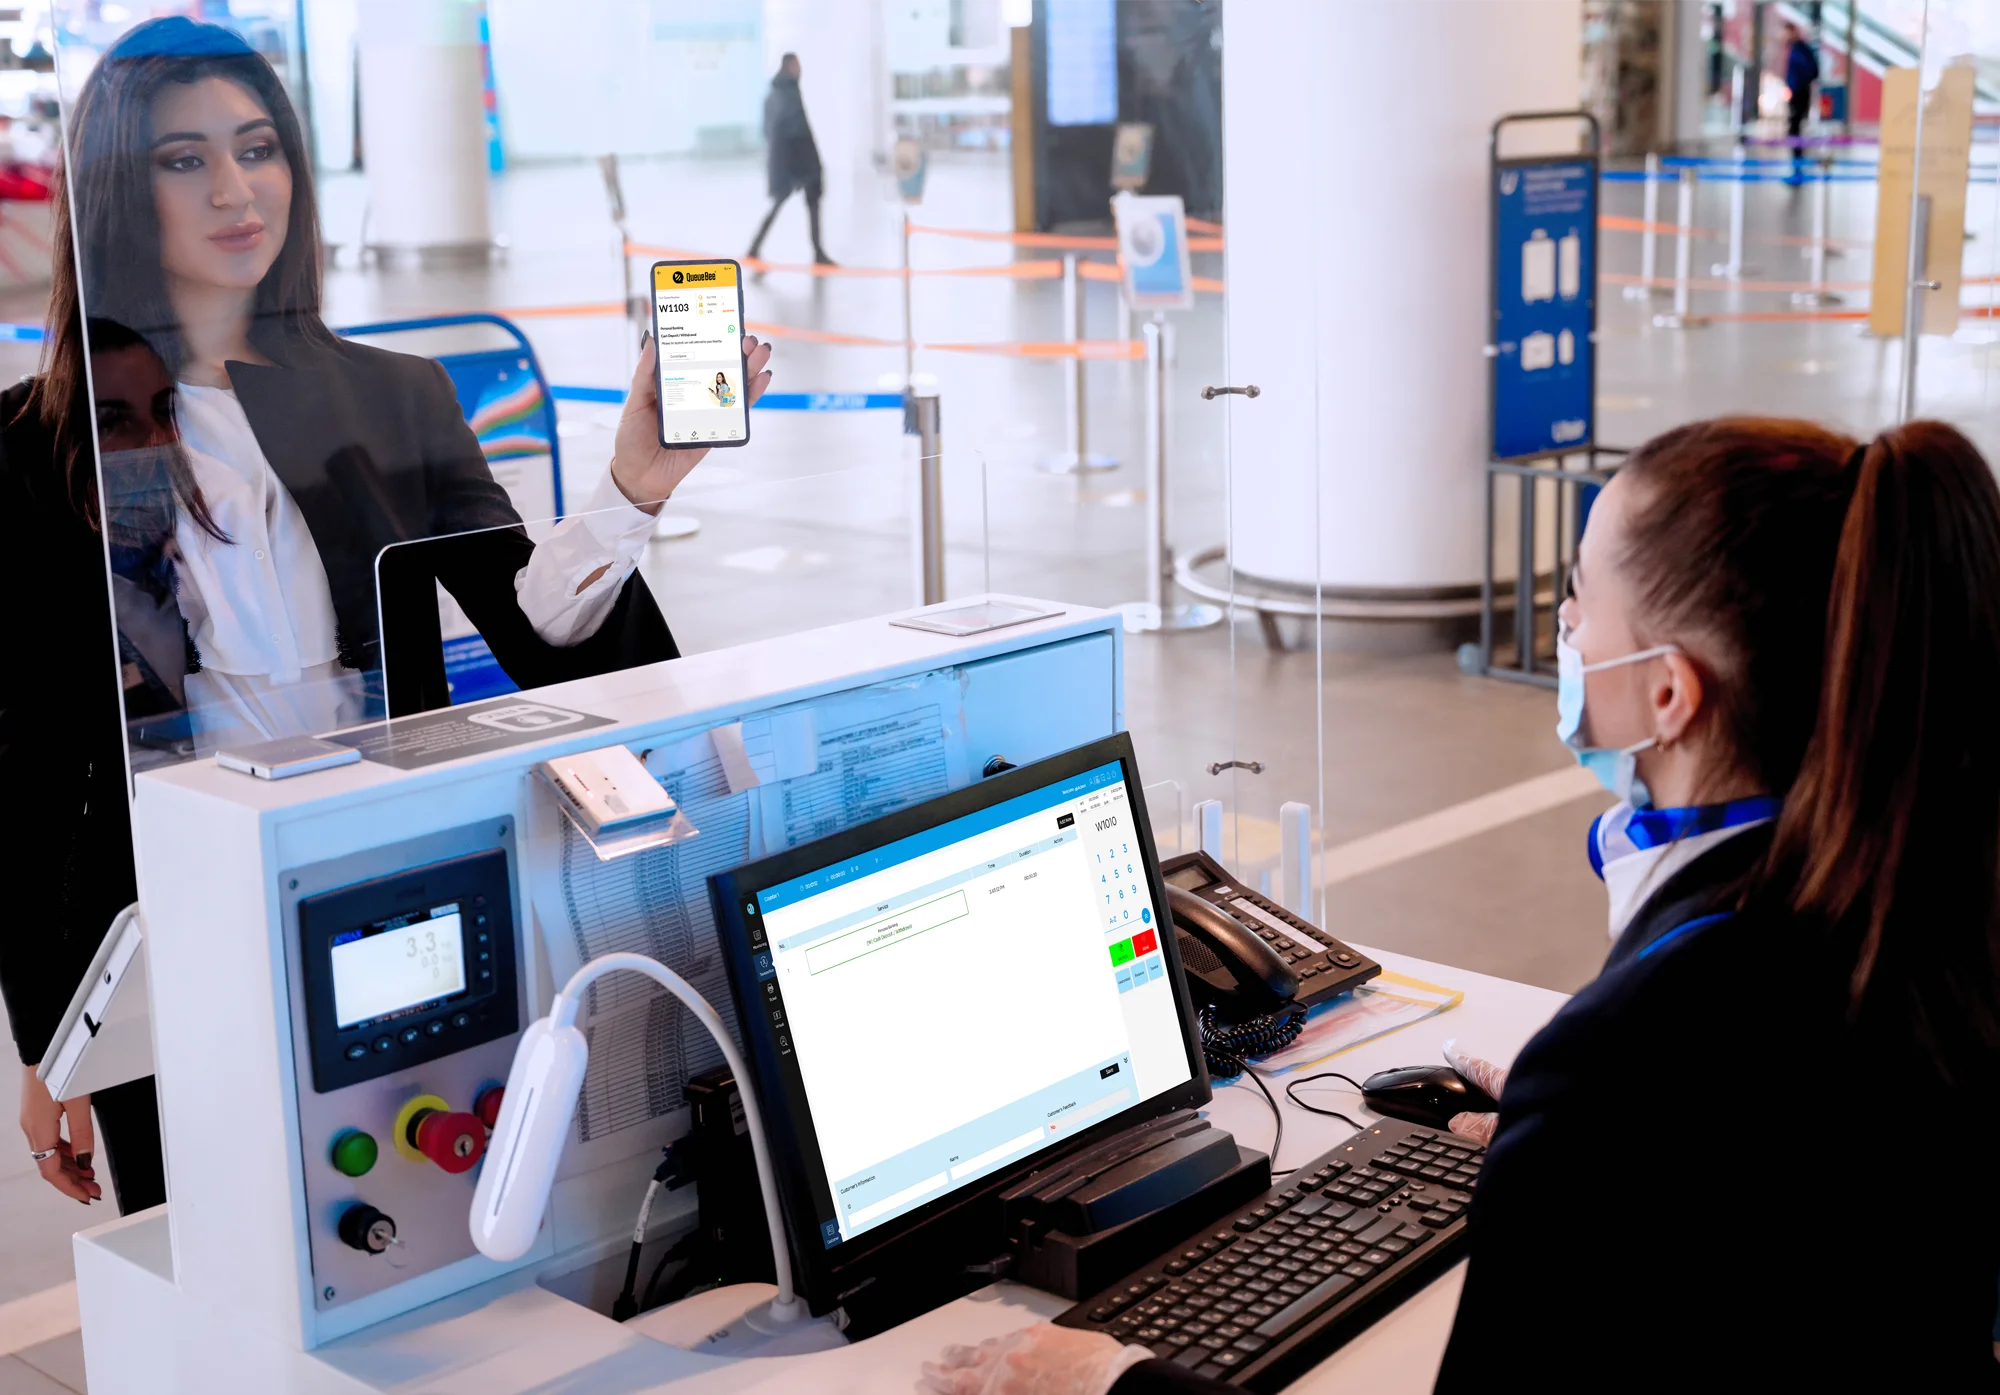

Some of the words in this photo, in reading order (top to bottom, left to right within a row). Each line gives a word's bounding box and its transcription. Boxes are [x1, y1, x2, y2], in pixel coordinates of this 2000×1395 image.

[686, 271, 717, 282] QueueBee
[658, 303, 690, 313] W1103
[1094, 815, 1118, 832] W1010
[1096, 854, 1101, 863] 1
[1109, 848, 1115, 858] 2
[1122, 843, 1128, 853] 3
[1101, 874, 1107, 883] 4
[1114, 868, 1119, 879] 5
[1127, 863, 1132, 873] 6
[876, 904, 889, 912] Service
[1018, 849, 1032, 858] Duration
[763, 894, 776, 902] Counter
[1105, 894, 1110, 904] 7
[1118, 889, 1124, 899] 8
[1131, 884, 1137, 894] 9
[1123, 909, 1129, 920] 0
[874, 936, 882, 944] Cash
[881, 931, 893, 941] Deposit
[406, 931, 437, 958] 3.3
[421, 953, 439, 968] 0.0
[433, 967, 440, 979] 0
[1105, 1067, 1114, 1075] Save
[1062, 1101, 1077, 1111] Feedback
[949, 1155, 959, 1163] Name
[840, 1183, 858, 1195] Customer's
[857, 1175, 876, 1187] Information
